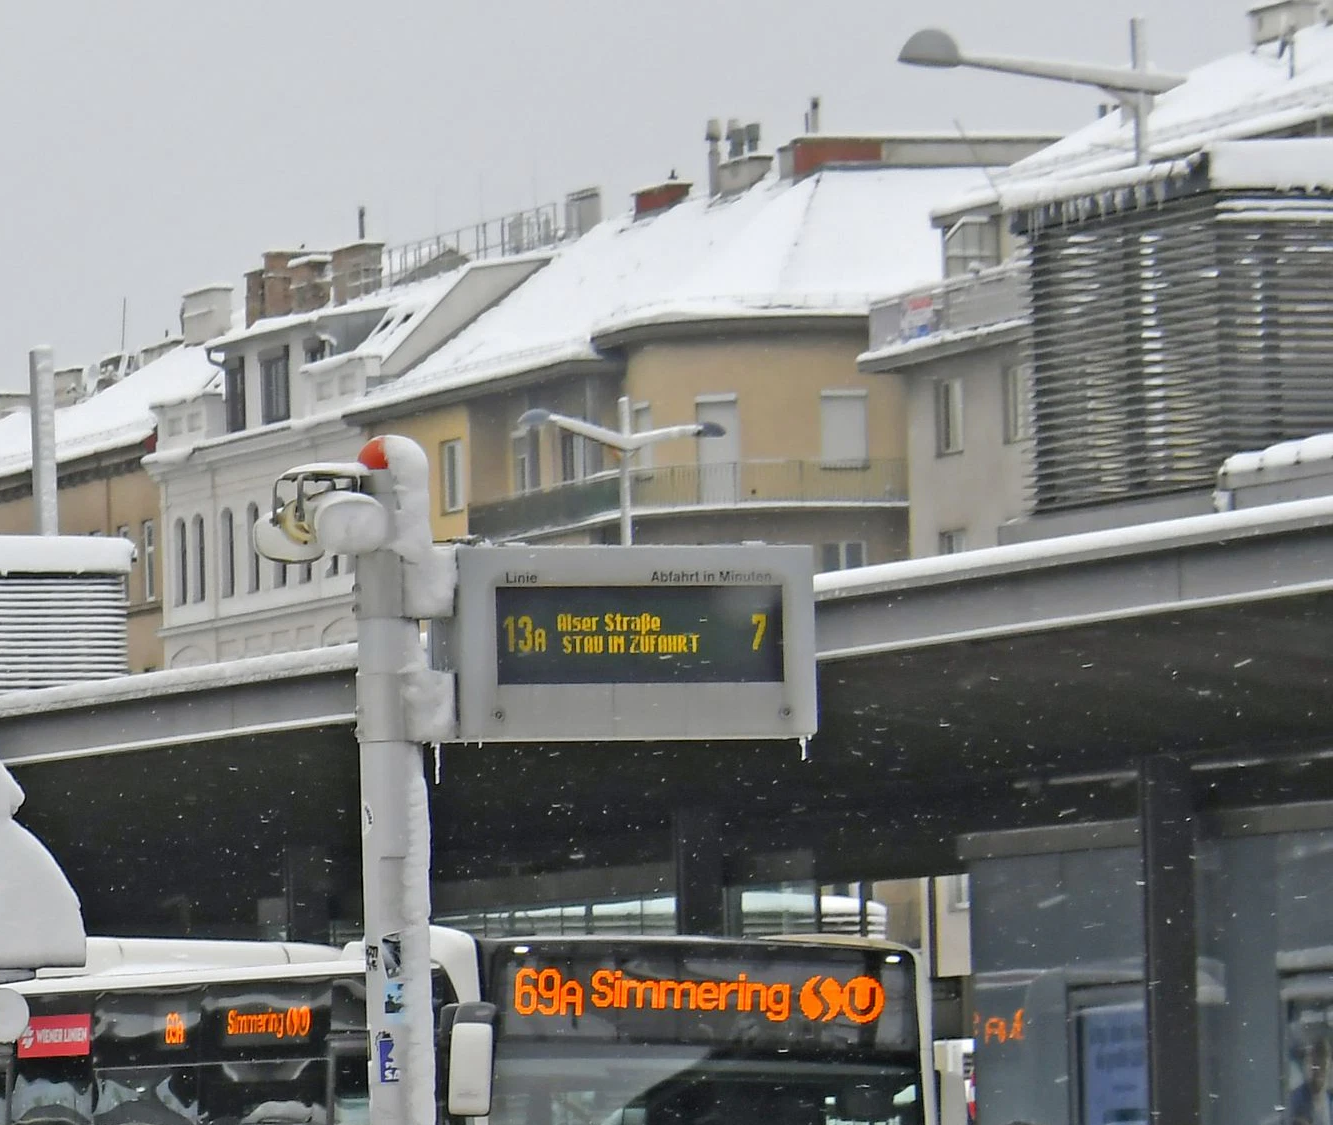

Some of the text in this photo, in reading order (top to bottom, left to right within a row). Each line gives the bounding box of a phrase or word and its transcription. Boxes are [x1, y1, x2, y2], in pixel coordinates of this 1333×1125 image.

[505, 572, 538, 584] Linie
[651, 570, 773, 583] Abfahrt in Minuten
[503, 615, 547, 653] 13A
[556, 612, 662, 635] Alser Straße
[750, 613, 768, 651] 7
[561, 633, 604, 654] STAU
[629, 633, 701, 654] ZUFAHRT
[513, 967, 584, 1017] 69A
[590, 968, 792, 1023] Simmering
[228, 1008, 283, 1038] Simmering
